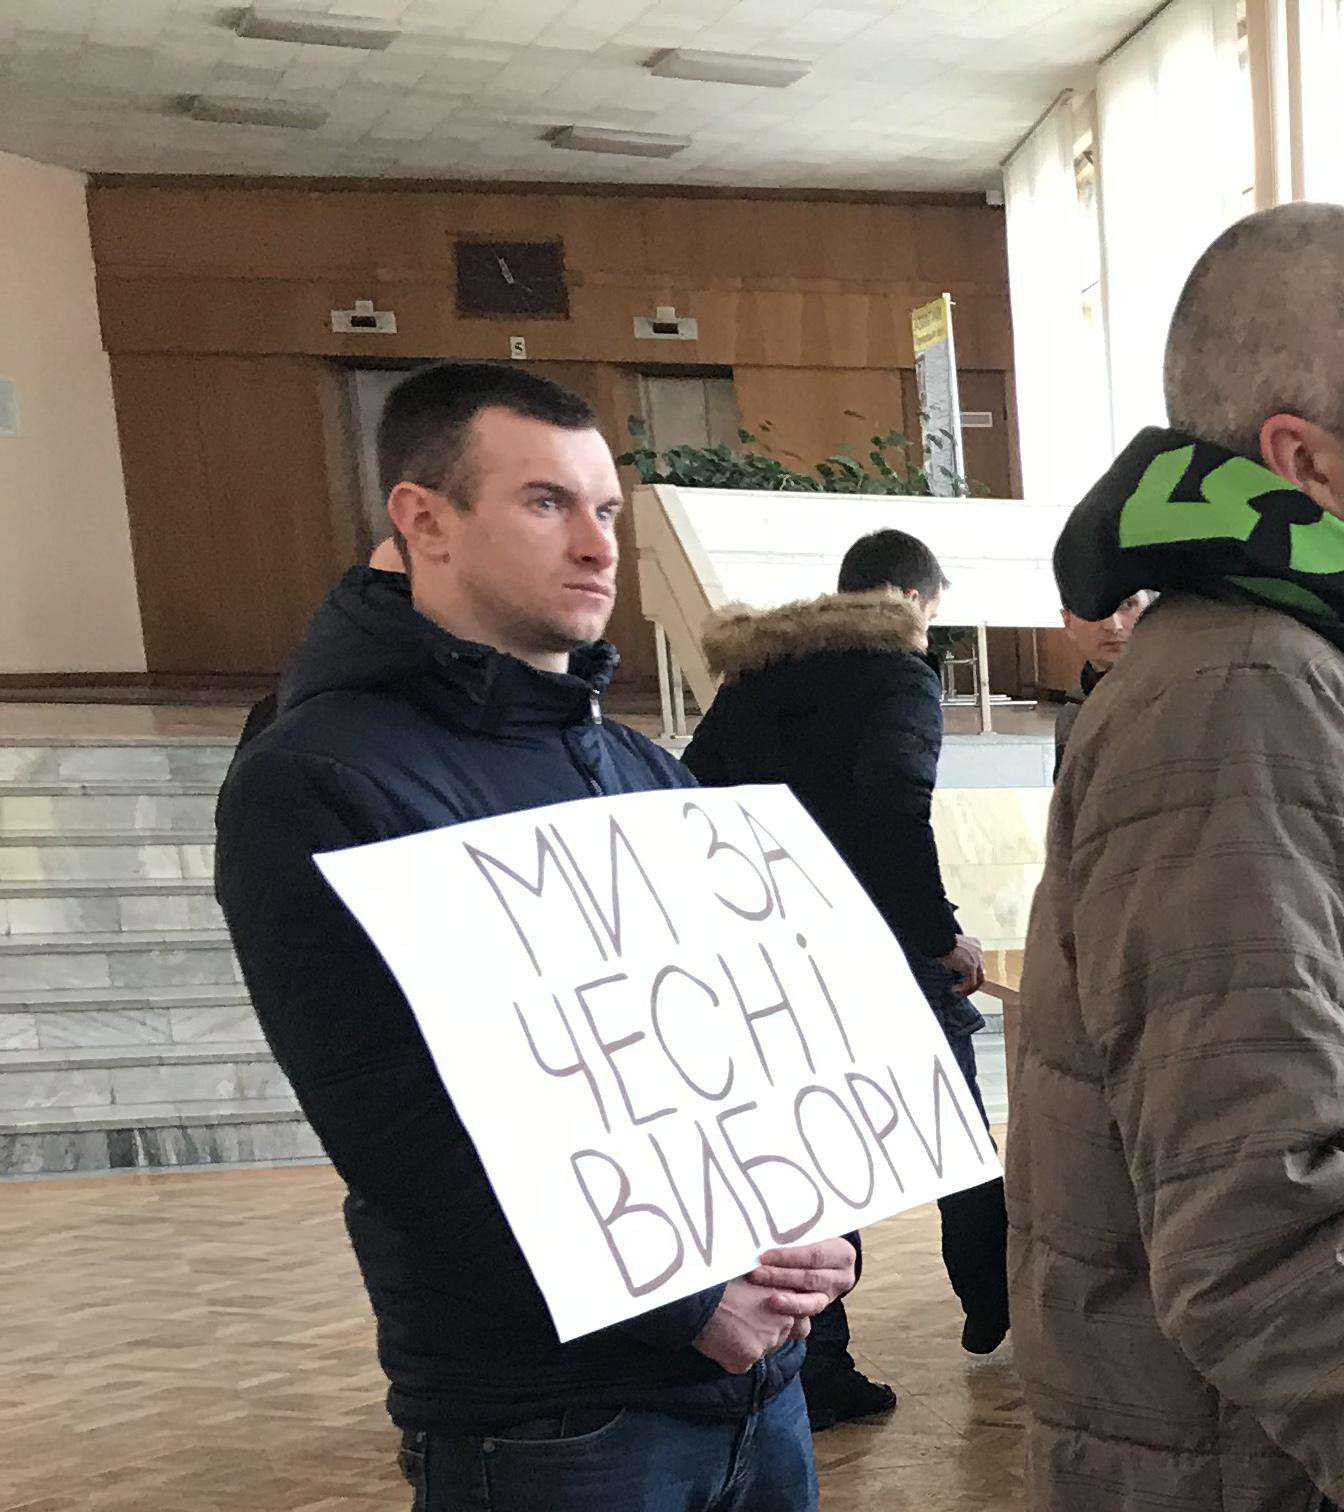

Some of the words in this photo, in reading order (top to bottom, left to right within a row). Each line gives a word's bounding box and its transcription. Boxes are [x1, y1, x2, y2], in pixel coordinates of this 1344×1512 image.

[462, 814, 679, 977] МИ
[682, 801, 834, 921] ЗА
[570, 1054, 985, 1298] ВИБОРИ
